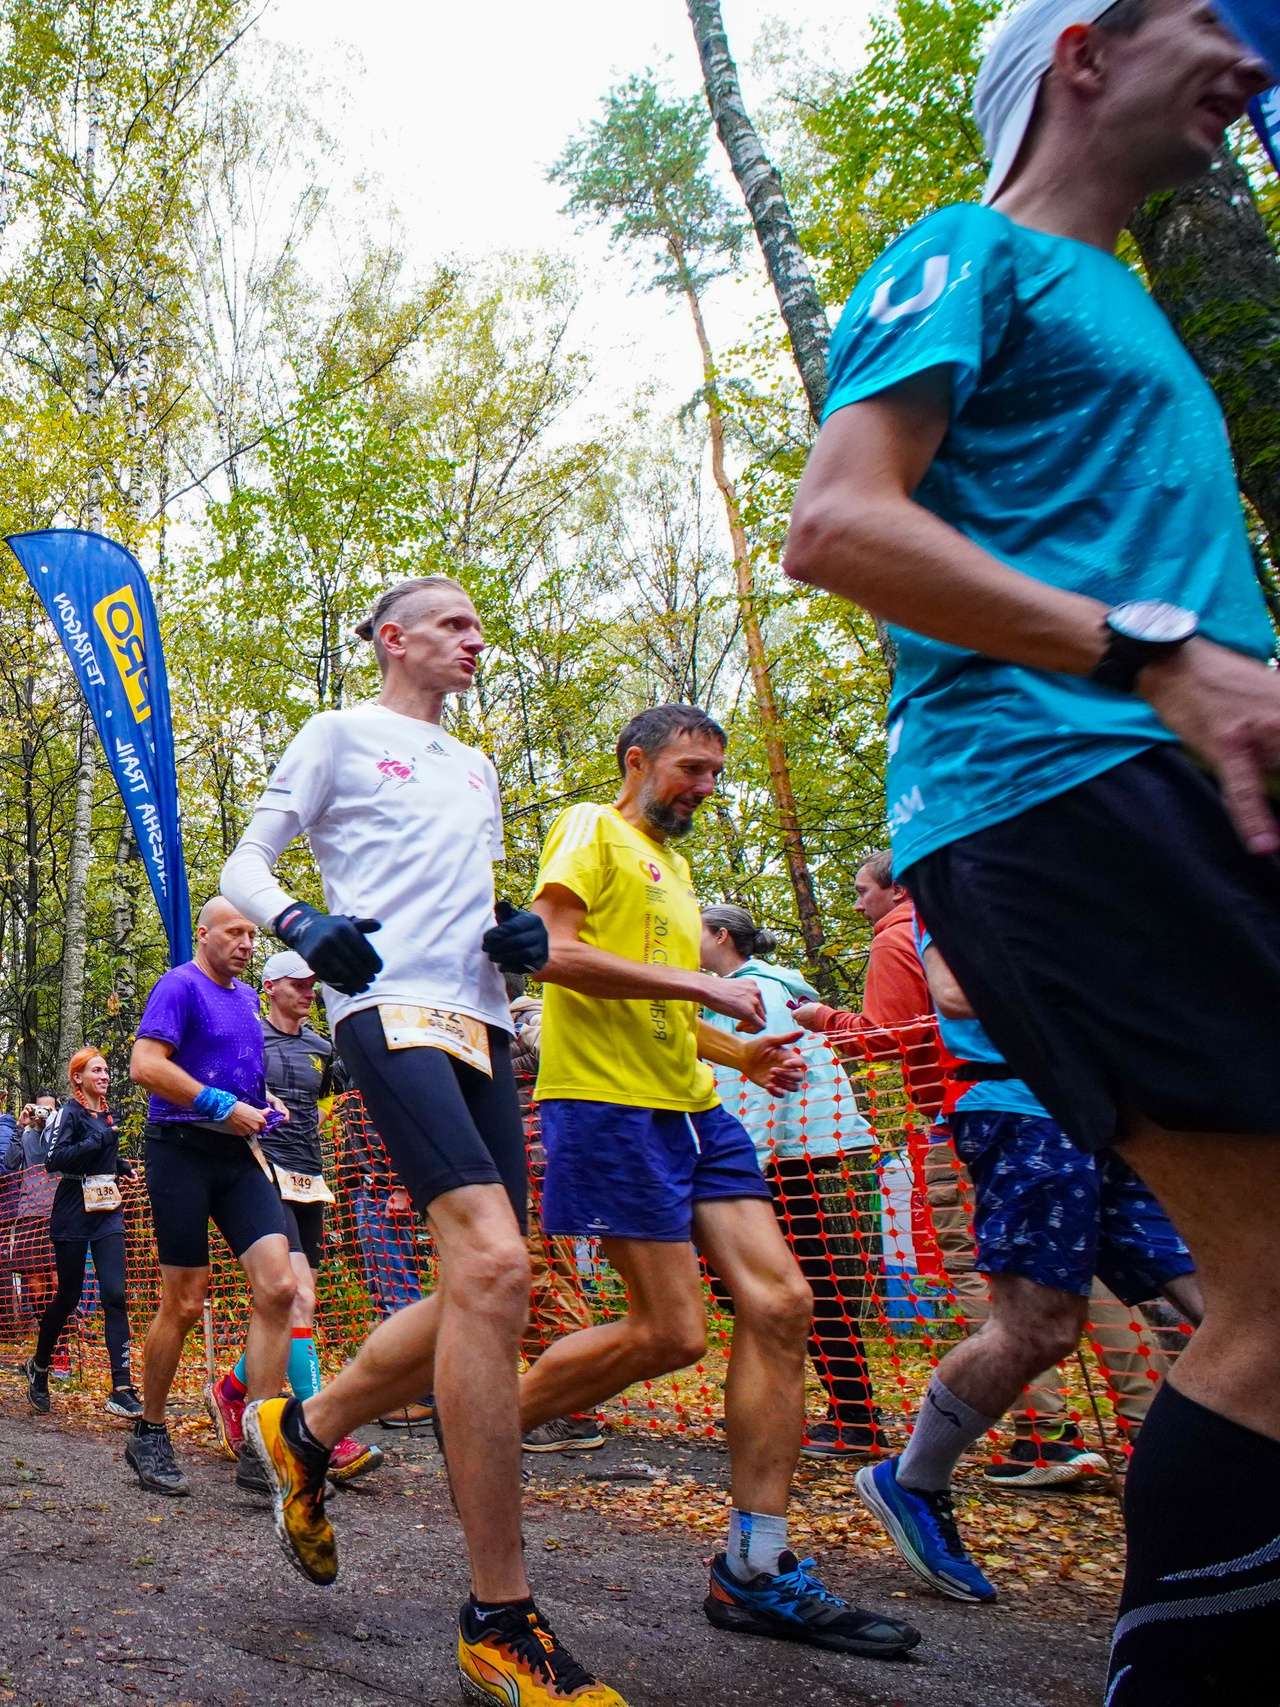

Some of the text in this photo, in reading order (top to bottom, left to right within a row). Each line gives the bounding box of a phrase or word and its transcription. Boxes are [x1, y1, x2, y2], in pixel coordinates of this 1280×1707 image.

[654, 915, 669, 937] 20
[291, 1176, 312, 1189] 149
[96, 1186, 114, 1196] 138
